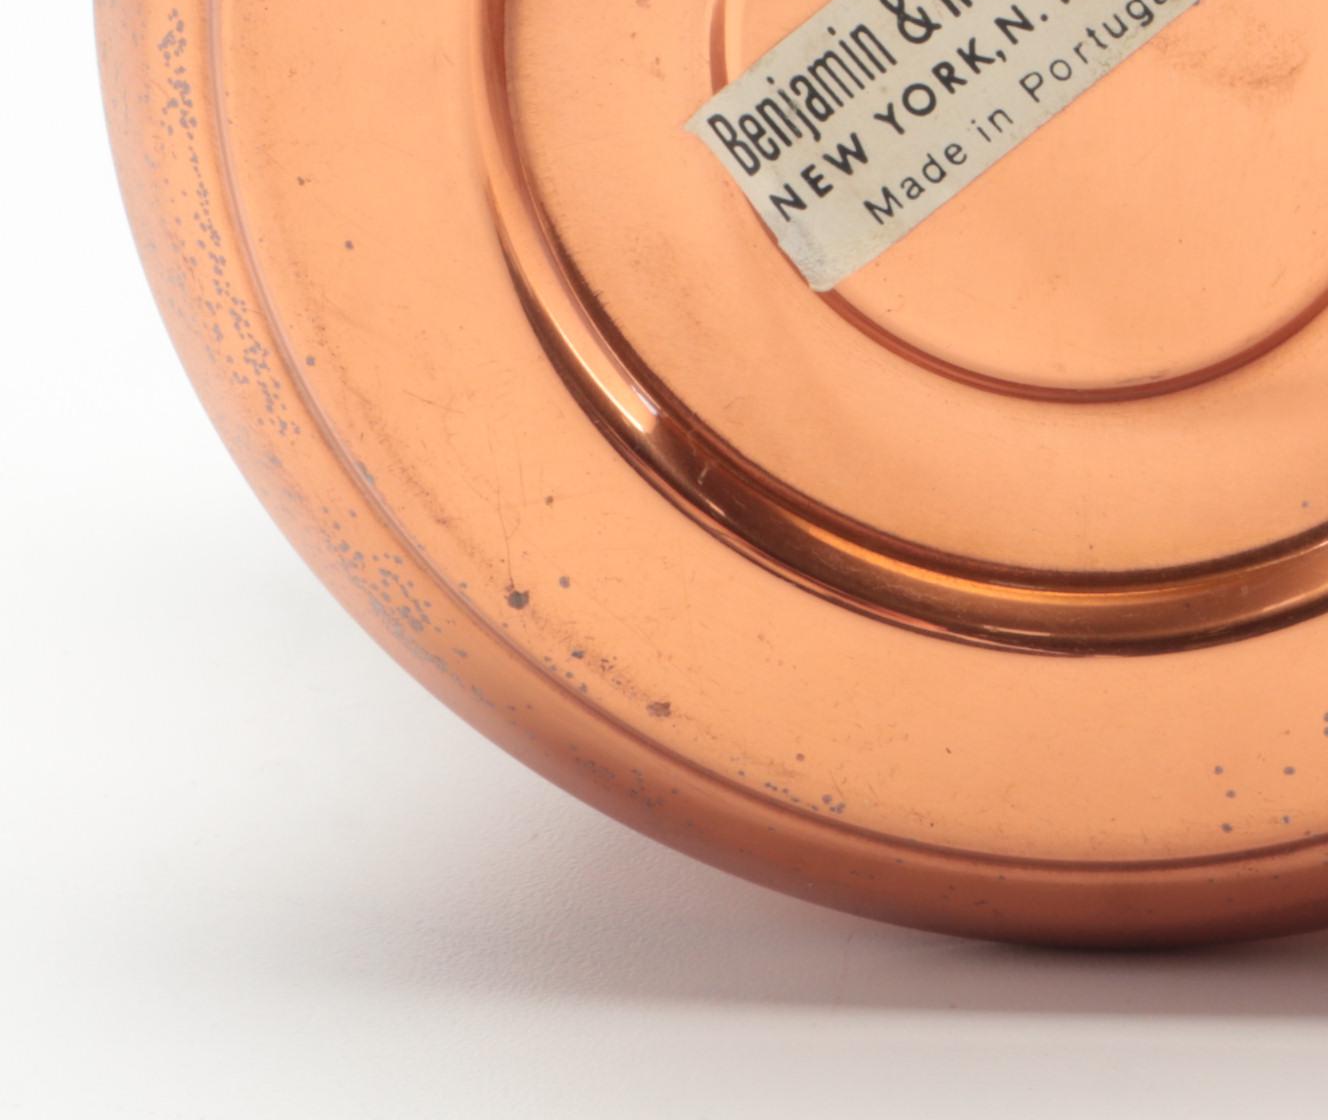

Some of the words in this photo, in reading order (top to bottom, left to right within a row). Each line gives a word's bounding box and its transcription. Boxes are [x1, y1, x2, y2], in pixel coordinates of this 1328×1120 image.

[707, 26, 897, 178] Benjamin
[769, 132, 869, 222] NEW
[863, 141, 968, 226] Made
[972, 106, 1014, 144] in
